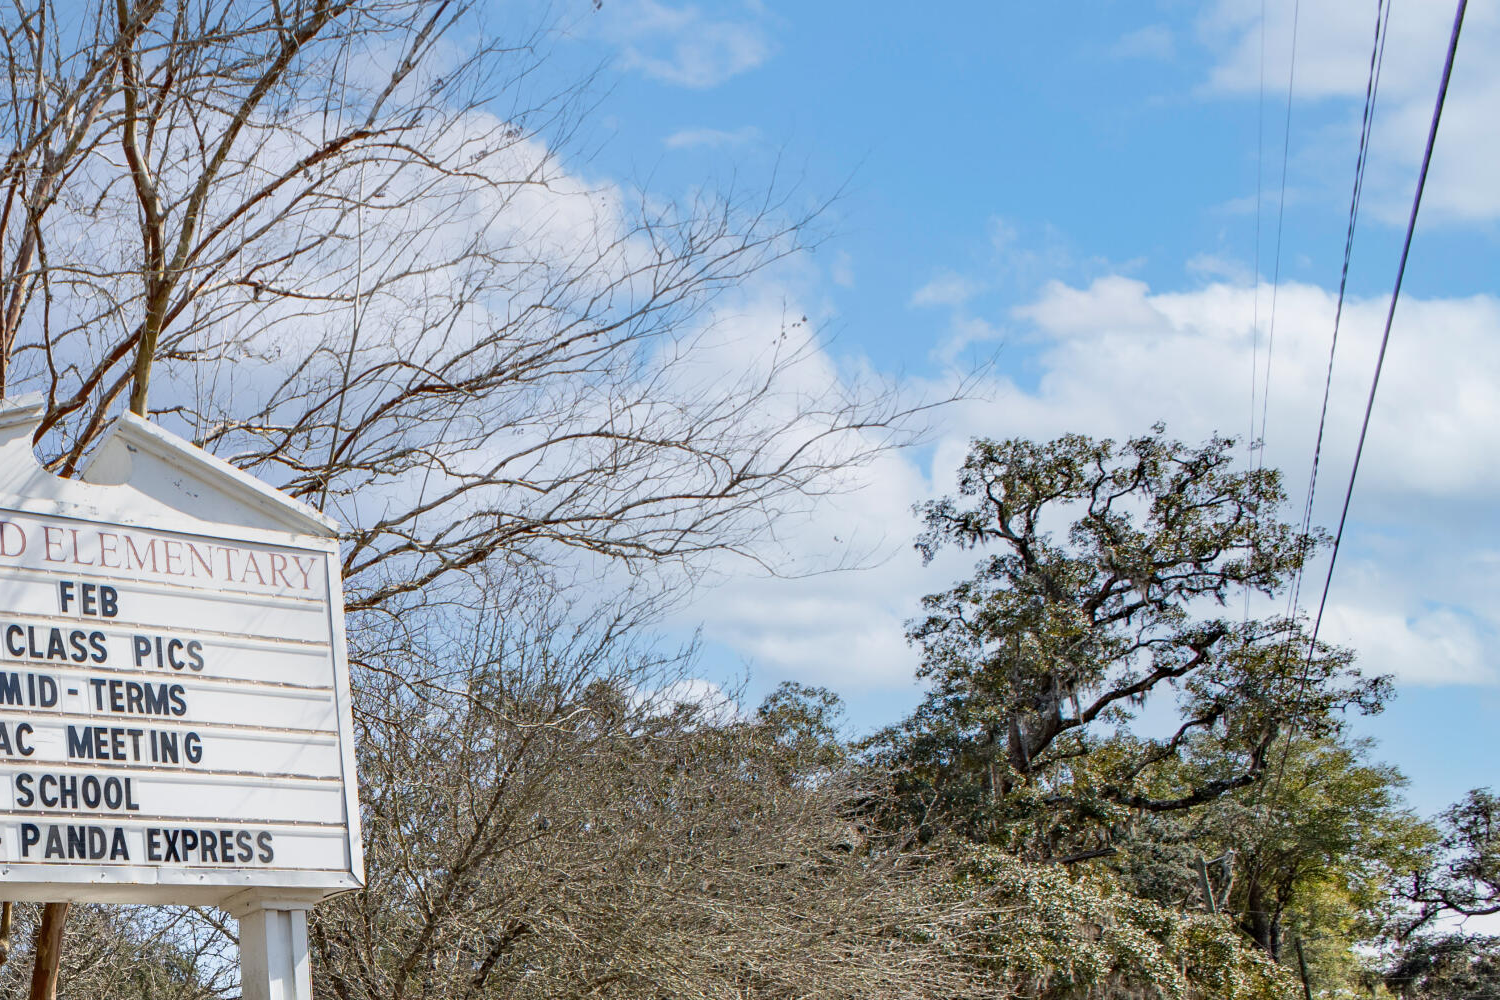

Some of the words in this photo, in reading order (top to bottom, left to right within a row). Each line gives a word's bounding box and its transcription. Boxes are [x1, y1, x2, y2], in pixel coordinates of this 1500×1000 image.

[43, 527, 317, 591] ELEMENTARY
[61, 582, 118, 617] FEB
[6, 625, 108, 664] CLASS
[134, 636, 203, 672] PICS
[68, 726, 201, 765] MEETING
[16, 773, 139, 811] SCHOOL
[21, 825, 129, 860] PANDA
[147, 829, 274, 863] EXPRESS
